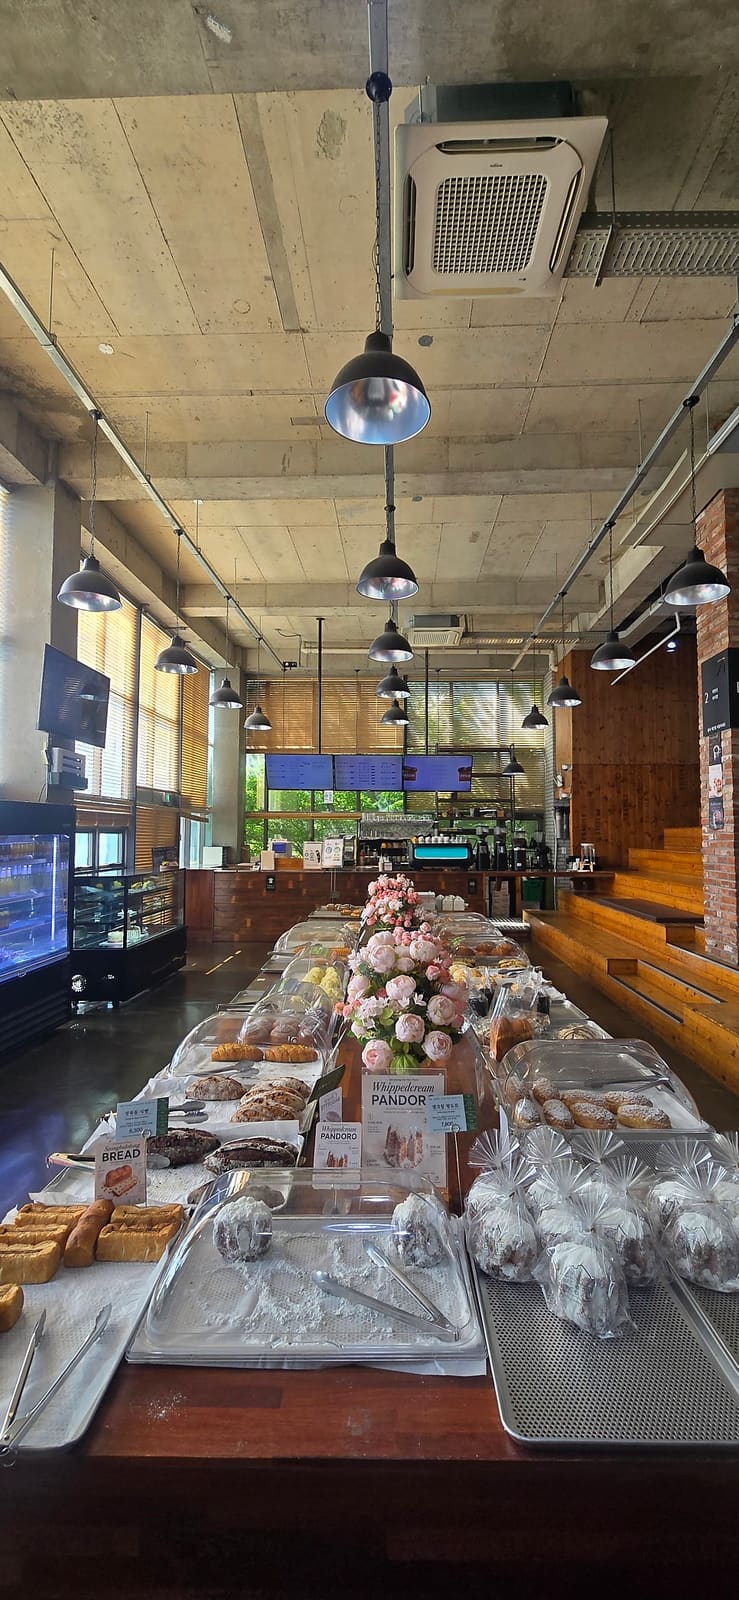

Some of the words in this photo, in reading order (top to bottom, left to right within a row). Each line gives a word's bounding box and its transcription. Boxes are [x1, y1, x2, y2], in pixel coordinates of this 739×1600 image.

[372, 1081, 435, 1094] Whippedcream
[371, 1094, 434, 1106] PANDOR
[320, 1132, 357, 1140] PANDORO
[102, 1148, 141, 1162] BREAD
